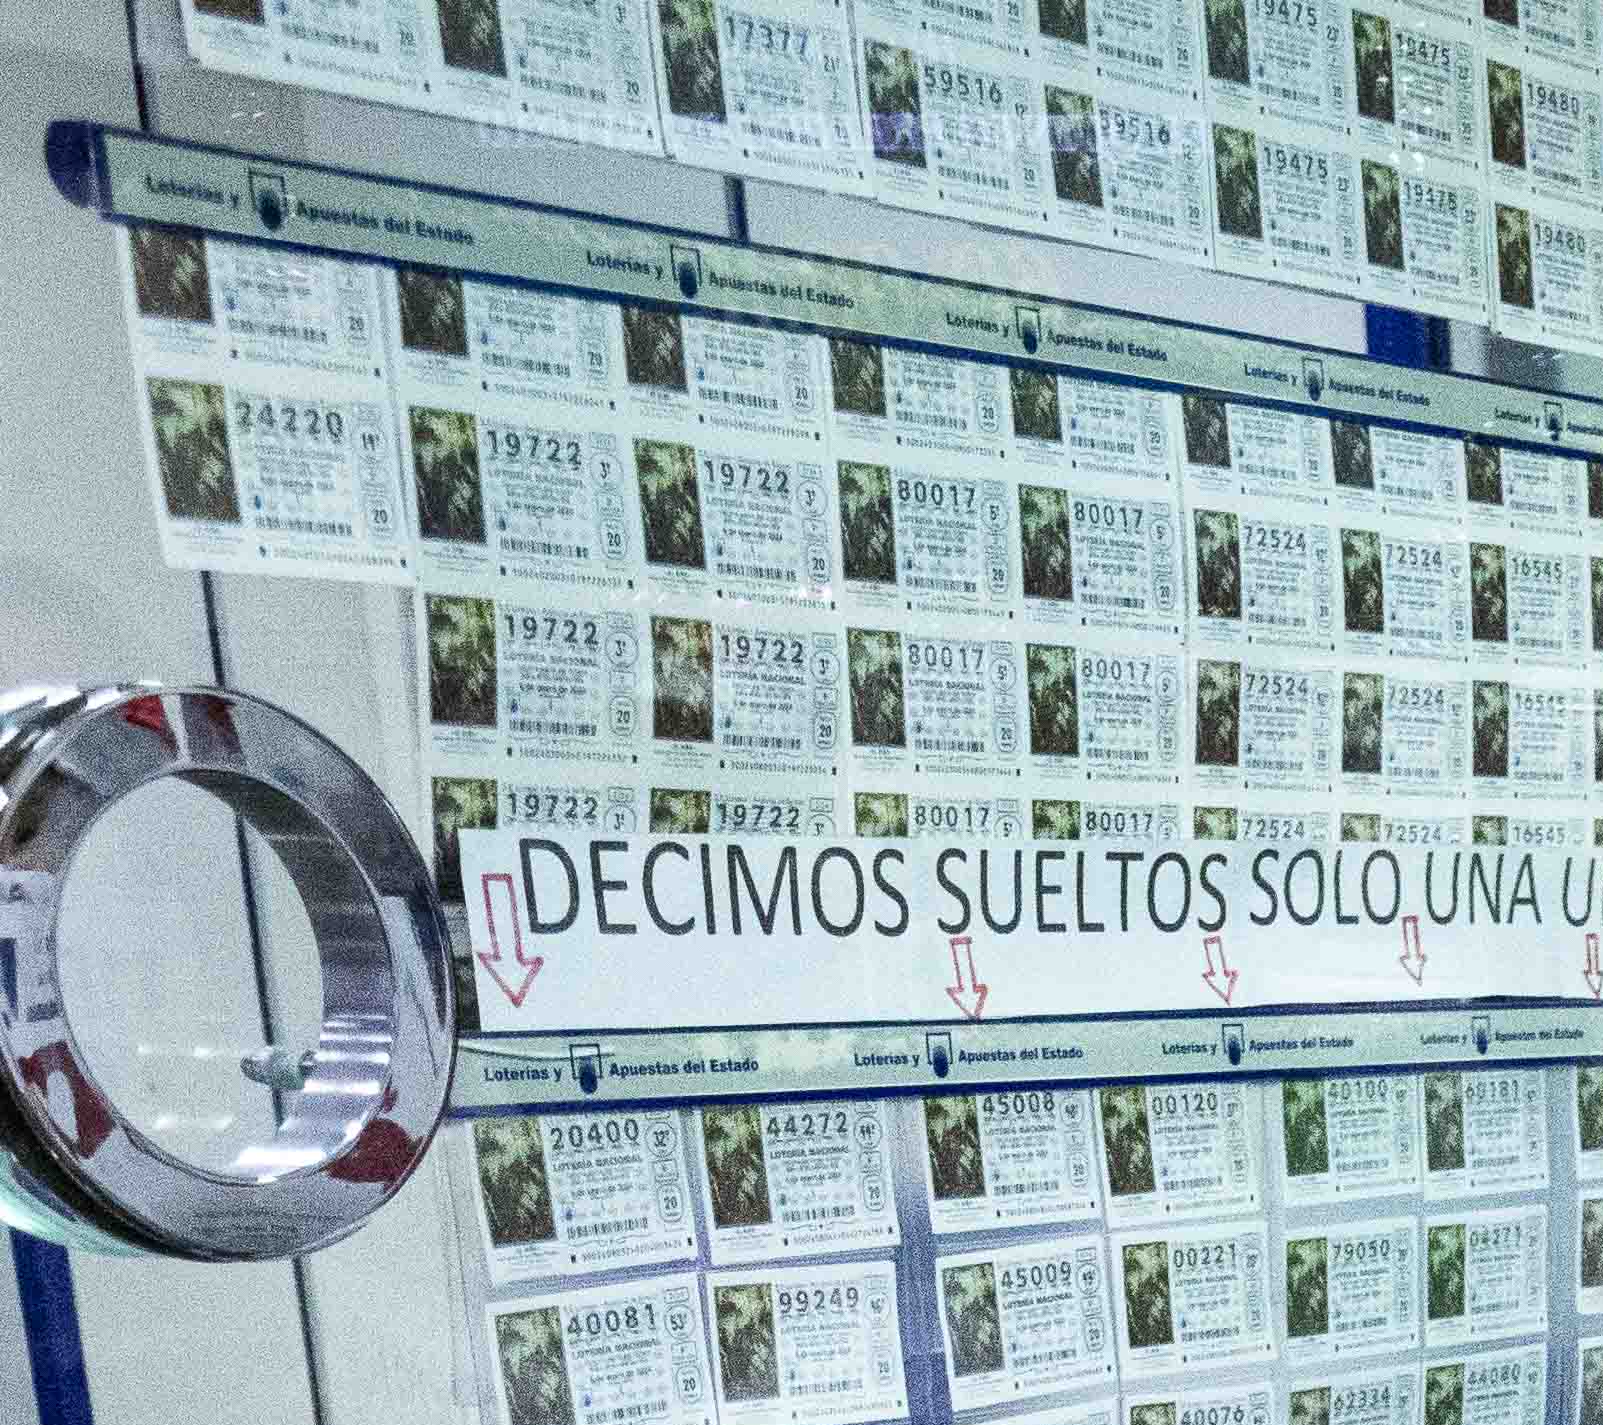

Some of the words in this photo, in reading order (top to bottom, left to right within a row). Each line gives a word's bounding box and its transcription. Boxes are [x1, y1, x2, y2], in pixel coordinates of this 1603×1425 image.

[415, 219, 474, 246] Estado
[781, 284, 803, 301] del
[806, 286, 855, 309] Estado
[486, 428, 582, 468] 19722
[704, 457, 789, 493] 19722
[899, 479, 976, 508] 80017
[1075, 502, 1143, 528] 80017
[1243, 525, 1306, 551] 72524
[1383, 542, 1441, 567] 72524
[505, 615, 598, 645] 19722
[720, 635, 803, 664] 19722
[908, 643, 984, 671] 80017
[1082, 657, 1151, 684] 80017
[1245, 673, 1308, 698] 72524
[508, 792, 598, 820] 19722
[718, 803, 799, 829] 19722
[915, 806, 989, 828] 80017
[1086, 810, 1154, 835] 80017
[1242, 818, 1306, 839] 72524
[1383, 821, 1441, 843] 72524
[1512, 825, 1565, 846] 16545
[518, 836, 911, 937] DECIMOS
[936, 846, 1228, 935] SUELTOS
[1250, 848, 1401, 927] SOLO
[1425, 850, 1542, 927] UNA
[853, 1050, 905, 1068] Loterías
[908, 1054, 920, 1068] y
[957, 1046, 1019, 1066] Apuestas
[1023, 1045, 1040, 1061] del
[1044, 1044, 1083, 1061] Estado
[484, 1064, 547, 1084] Loterías
[550, 1069, 562, 1083] y
[609, 1059, 681, 1079] Apuestas
[685, 1057, 707, 1074] del
[710, 1056, 759, 1074] Estado
[1153, 1094, 1217, 1116] 00120
[551, 1119, 640, 1148] 20400
[766, 1110, 848, 1139] 44272
[1173, 1243, 1236, 1269] 00221
[1000, 1262, 1072, 1291] 45009
[567, 1305, 658, 1335] 40081
